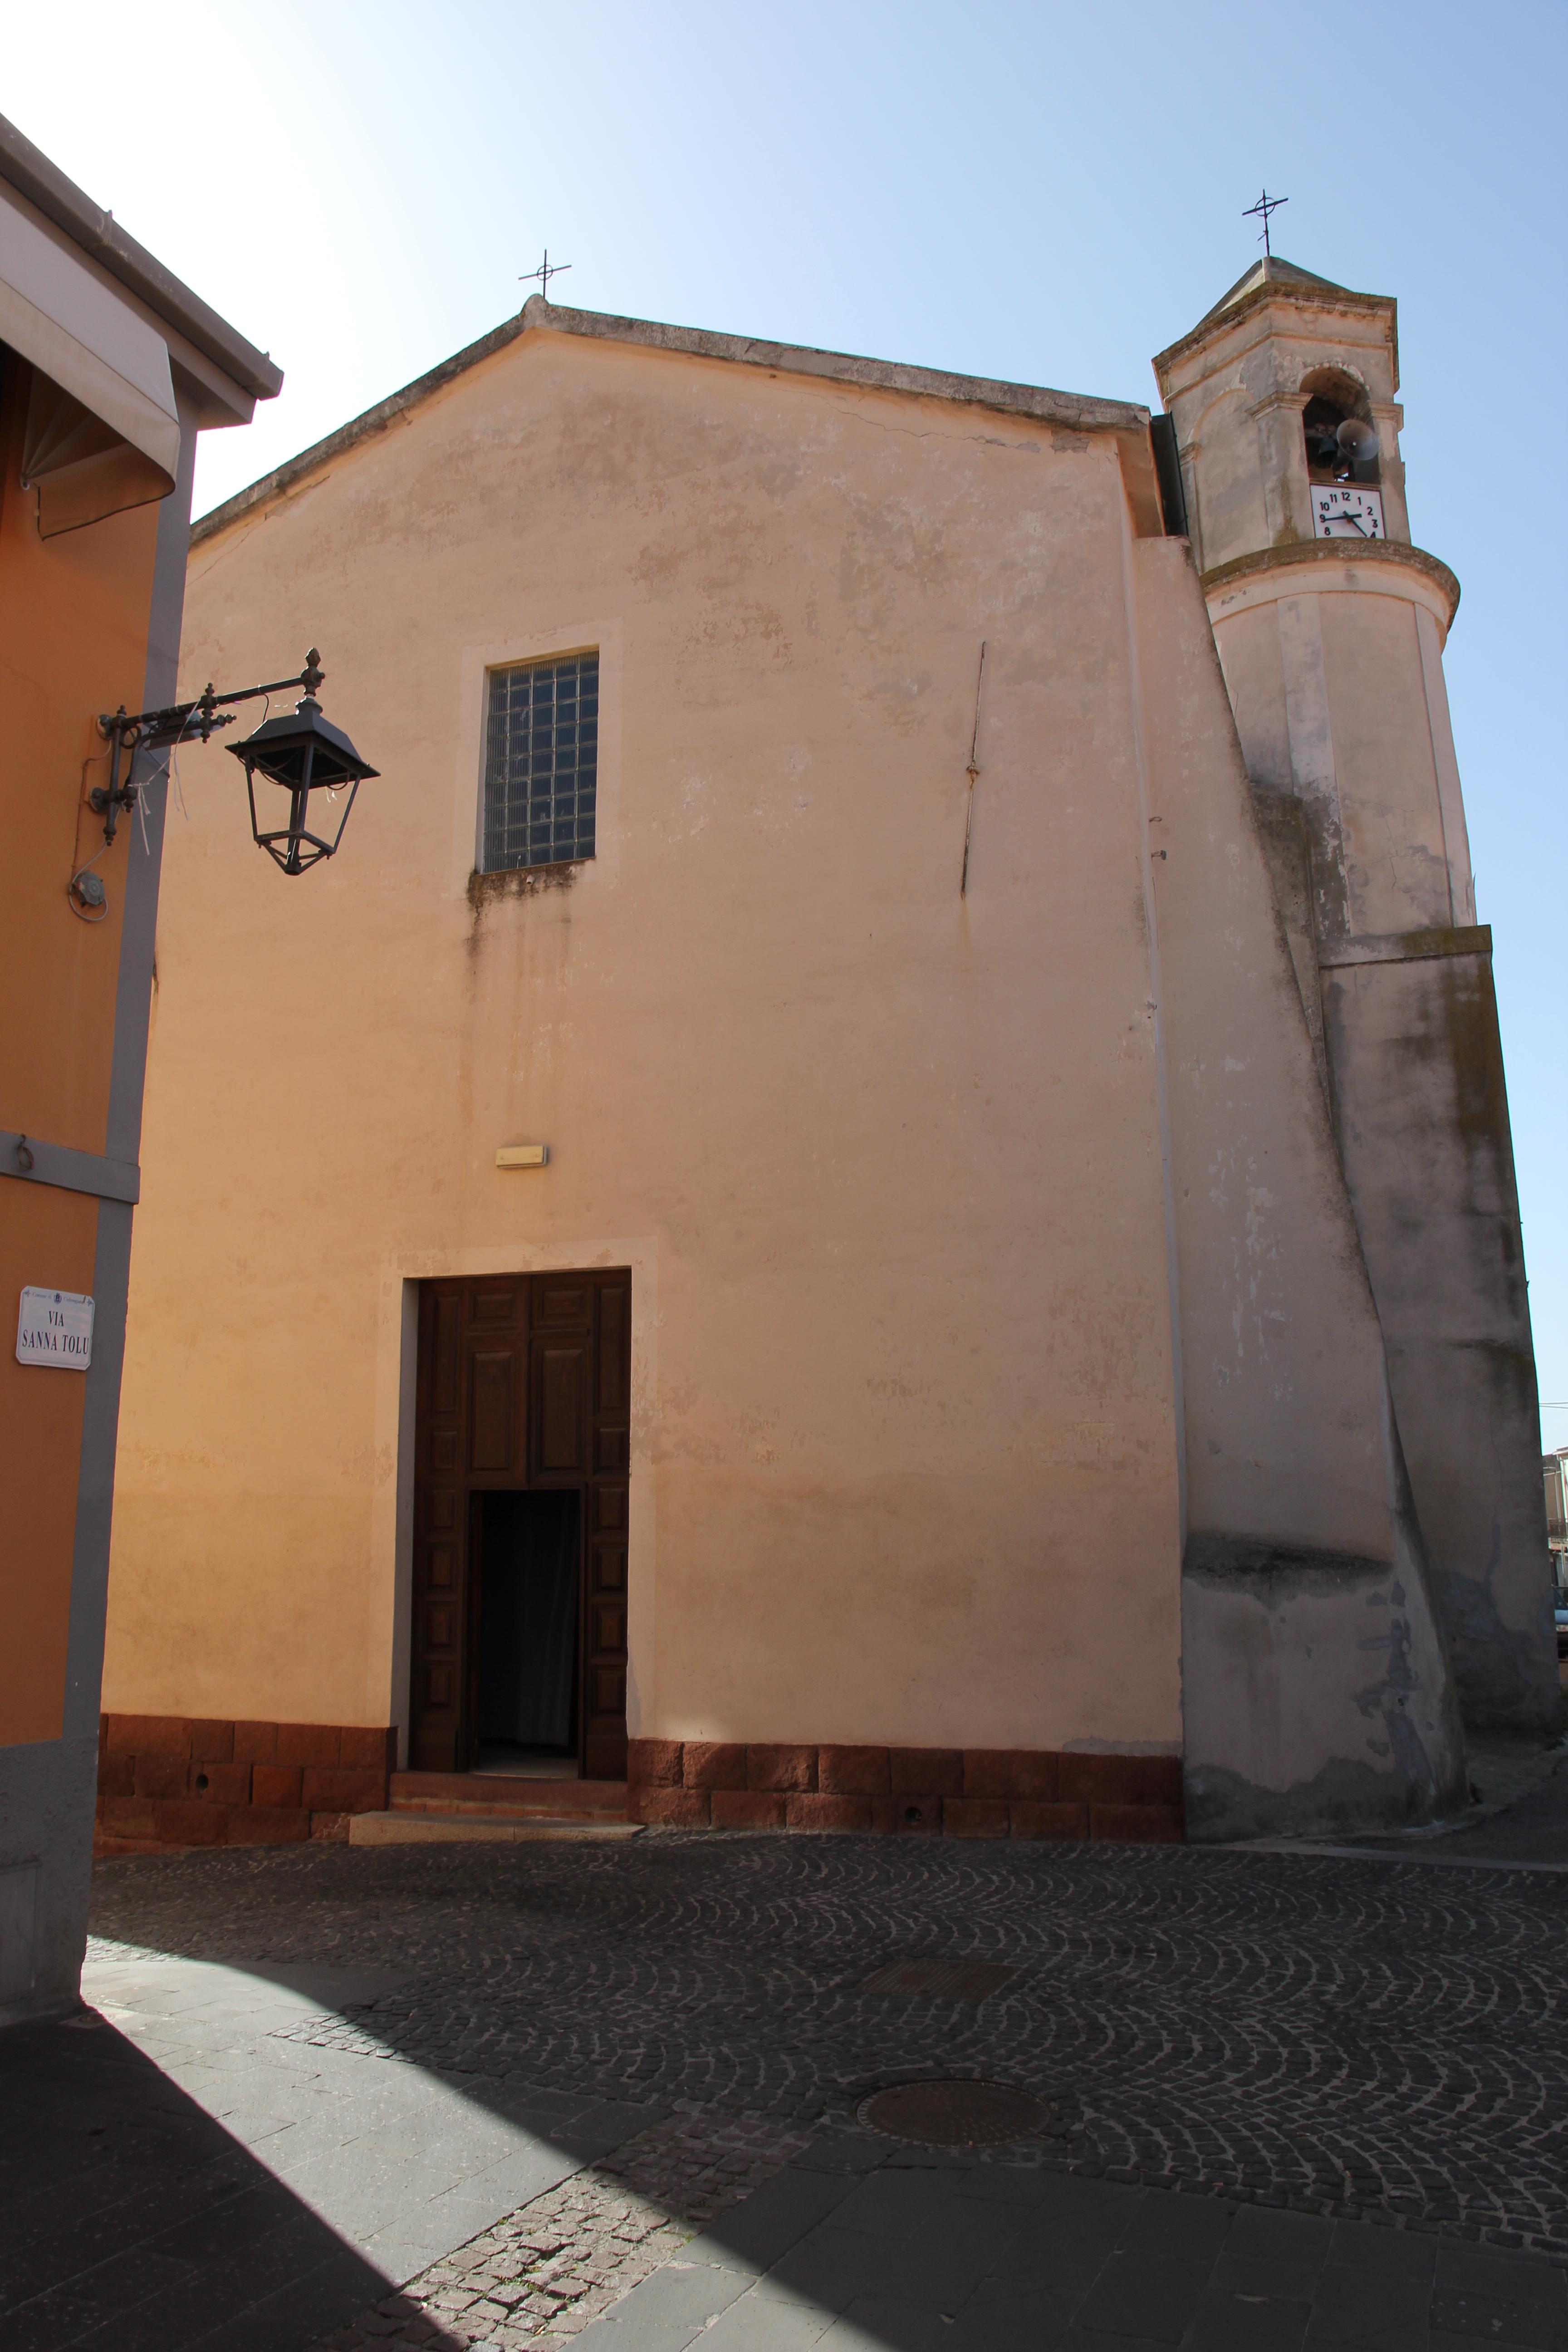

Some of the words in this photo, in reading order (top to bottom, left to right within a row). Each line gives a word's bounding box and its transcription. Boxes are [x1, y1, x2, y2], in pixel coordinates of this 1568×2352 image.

[1329, 494, 1338, 503] 11
[1341, 492, 1351, 501] 12
[1357, 497, 1361, 505] 1
[1320, 502, 1329, 511] 10
[1367, 506, 1373, 515] 2
[1319, 514, 1326, 523] 9
[1372, 519, 1378, 528] 3
[1324, 527, 1331, 535] 8
[49, 1311, 64, 1326] VIA
[22, 1329, 57, 1351] SANNA
[63, 1335, 89, 1354] TOLU
